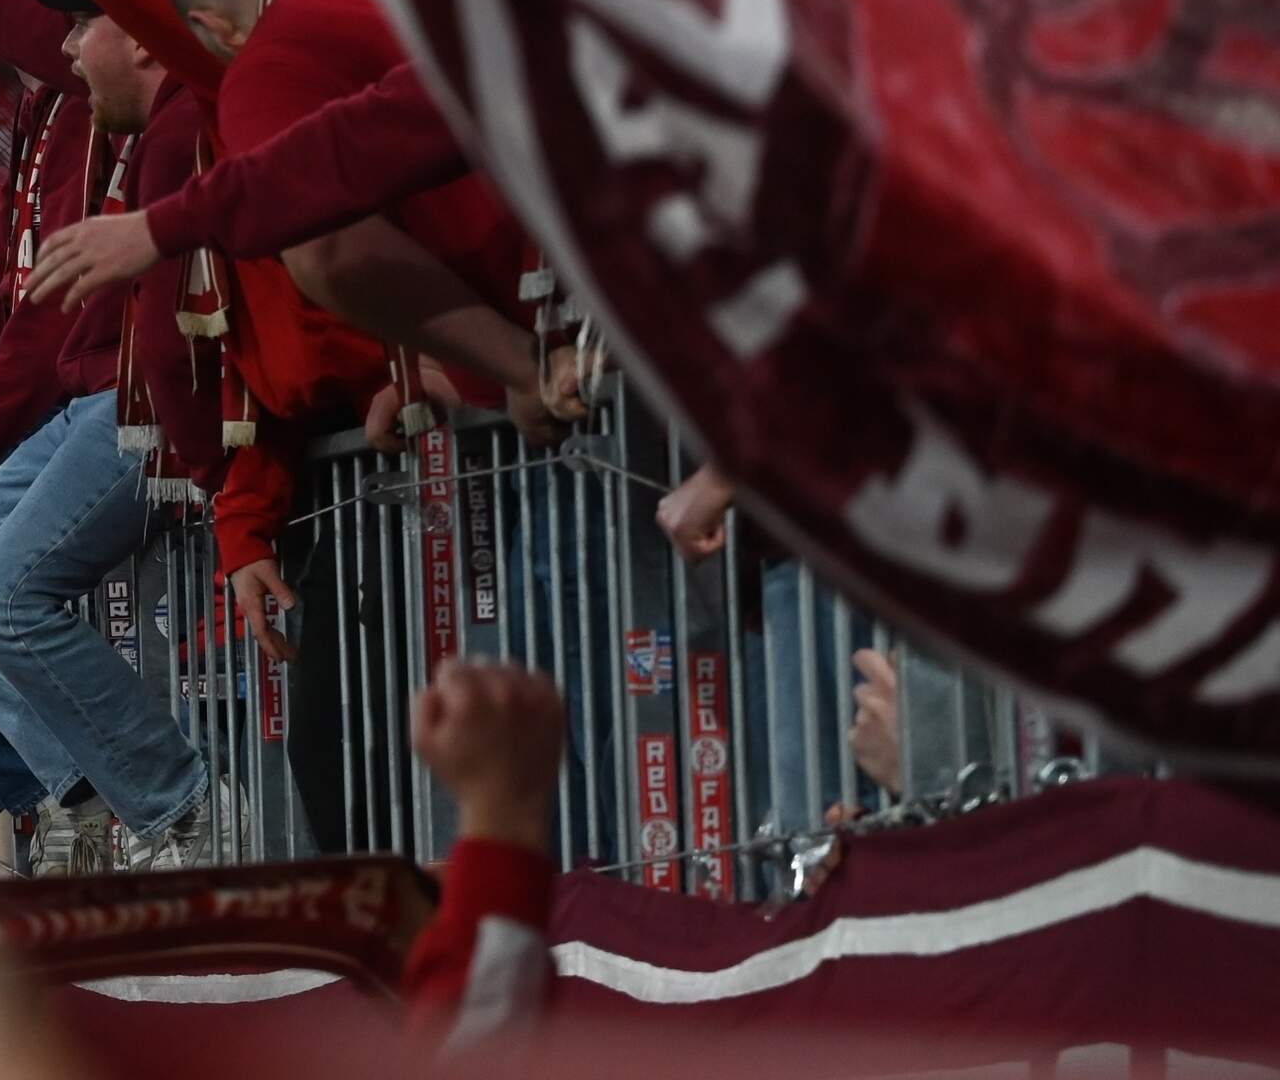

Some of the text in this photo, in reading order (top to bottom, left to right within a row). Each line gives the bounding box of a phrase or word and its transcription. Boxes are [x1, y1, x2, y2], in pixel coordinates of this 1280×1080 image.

[431, 539, 452, 659] FANAT
[475, 572, 496, 620] RED
[645, 741, 669, 814] RED
[696, 657, 724, 900] RED FANAT
